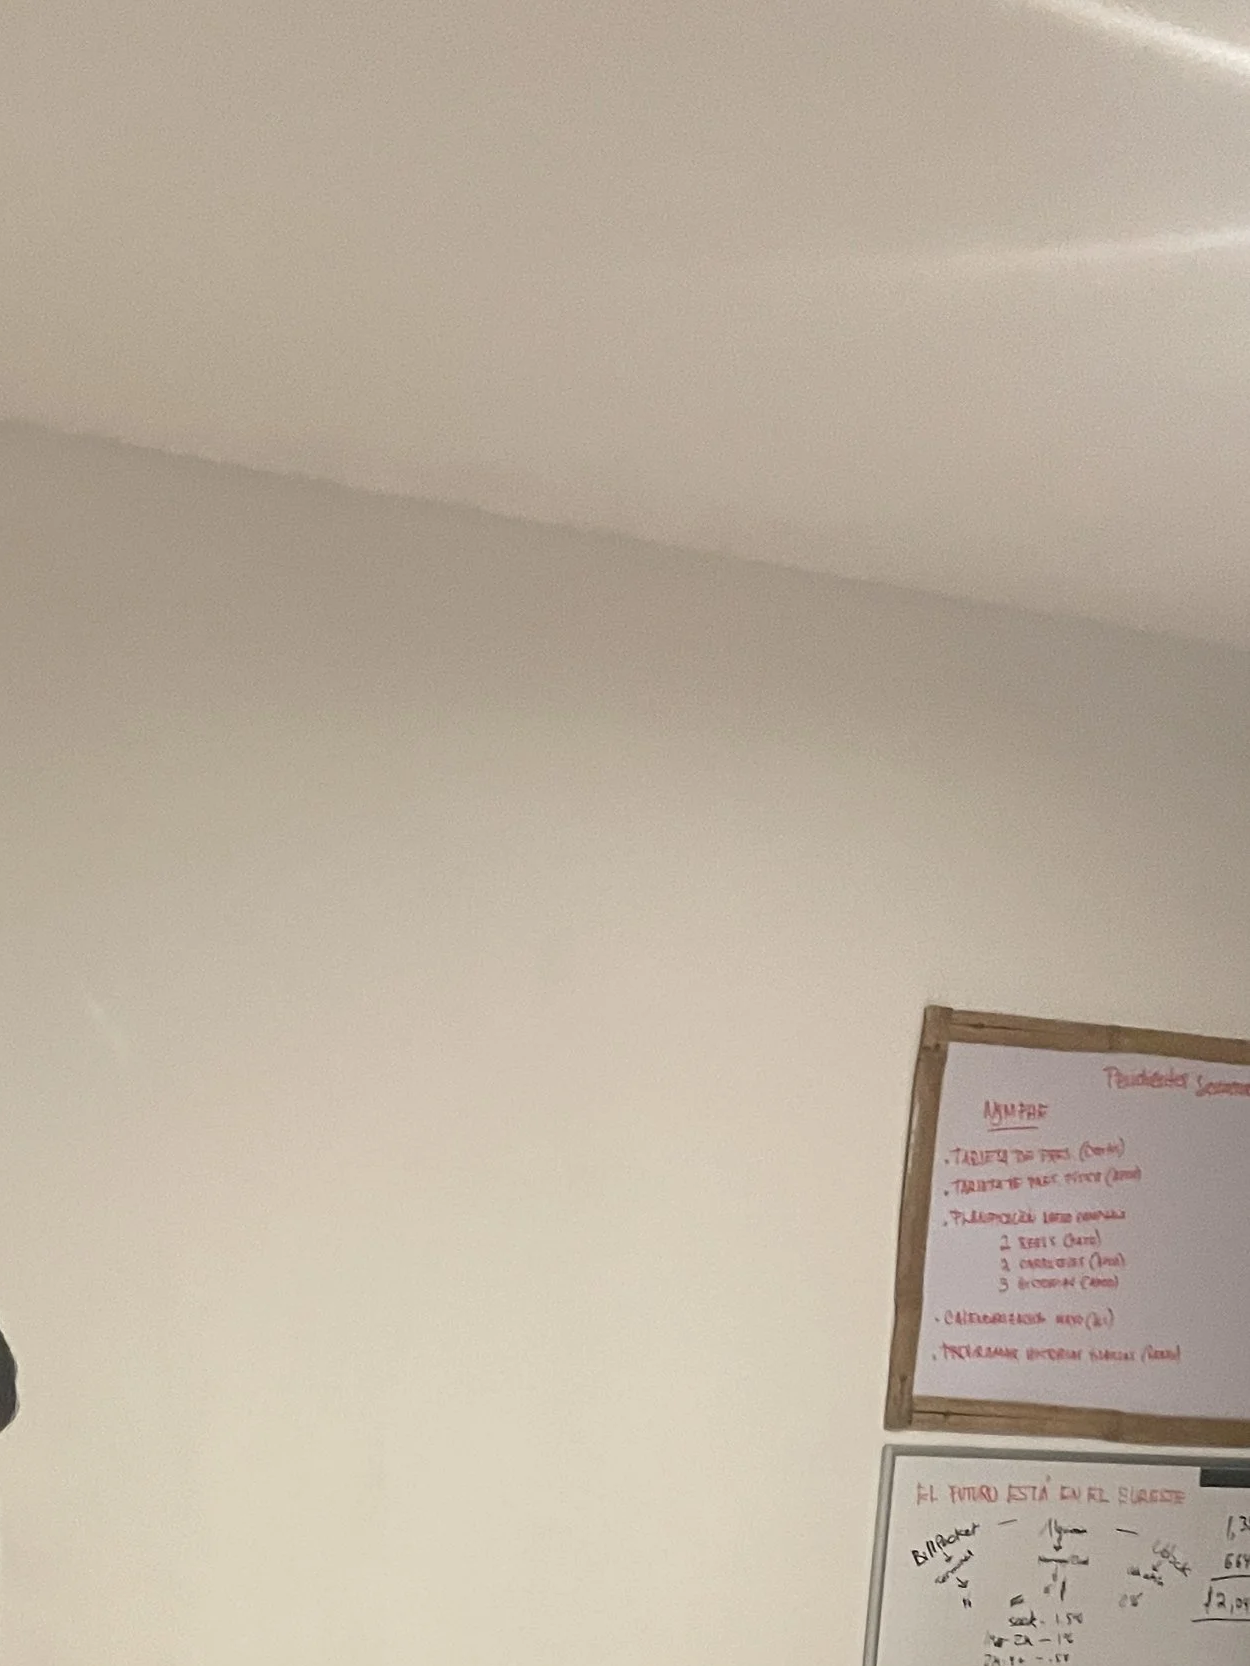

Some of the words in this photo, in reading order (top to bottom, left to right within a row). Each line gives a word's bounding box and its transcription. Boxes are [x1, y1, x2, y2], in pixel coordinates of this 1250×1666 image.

[917, 1482, 939, 1505] EL
[948, 1484, 999, 1504] FUTURO
[1060, 1484, 1081, 1503] EN
